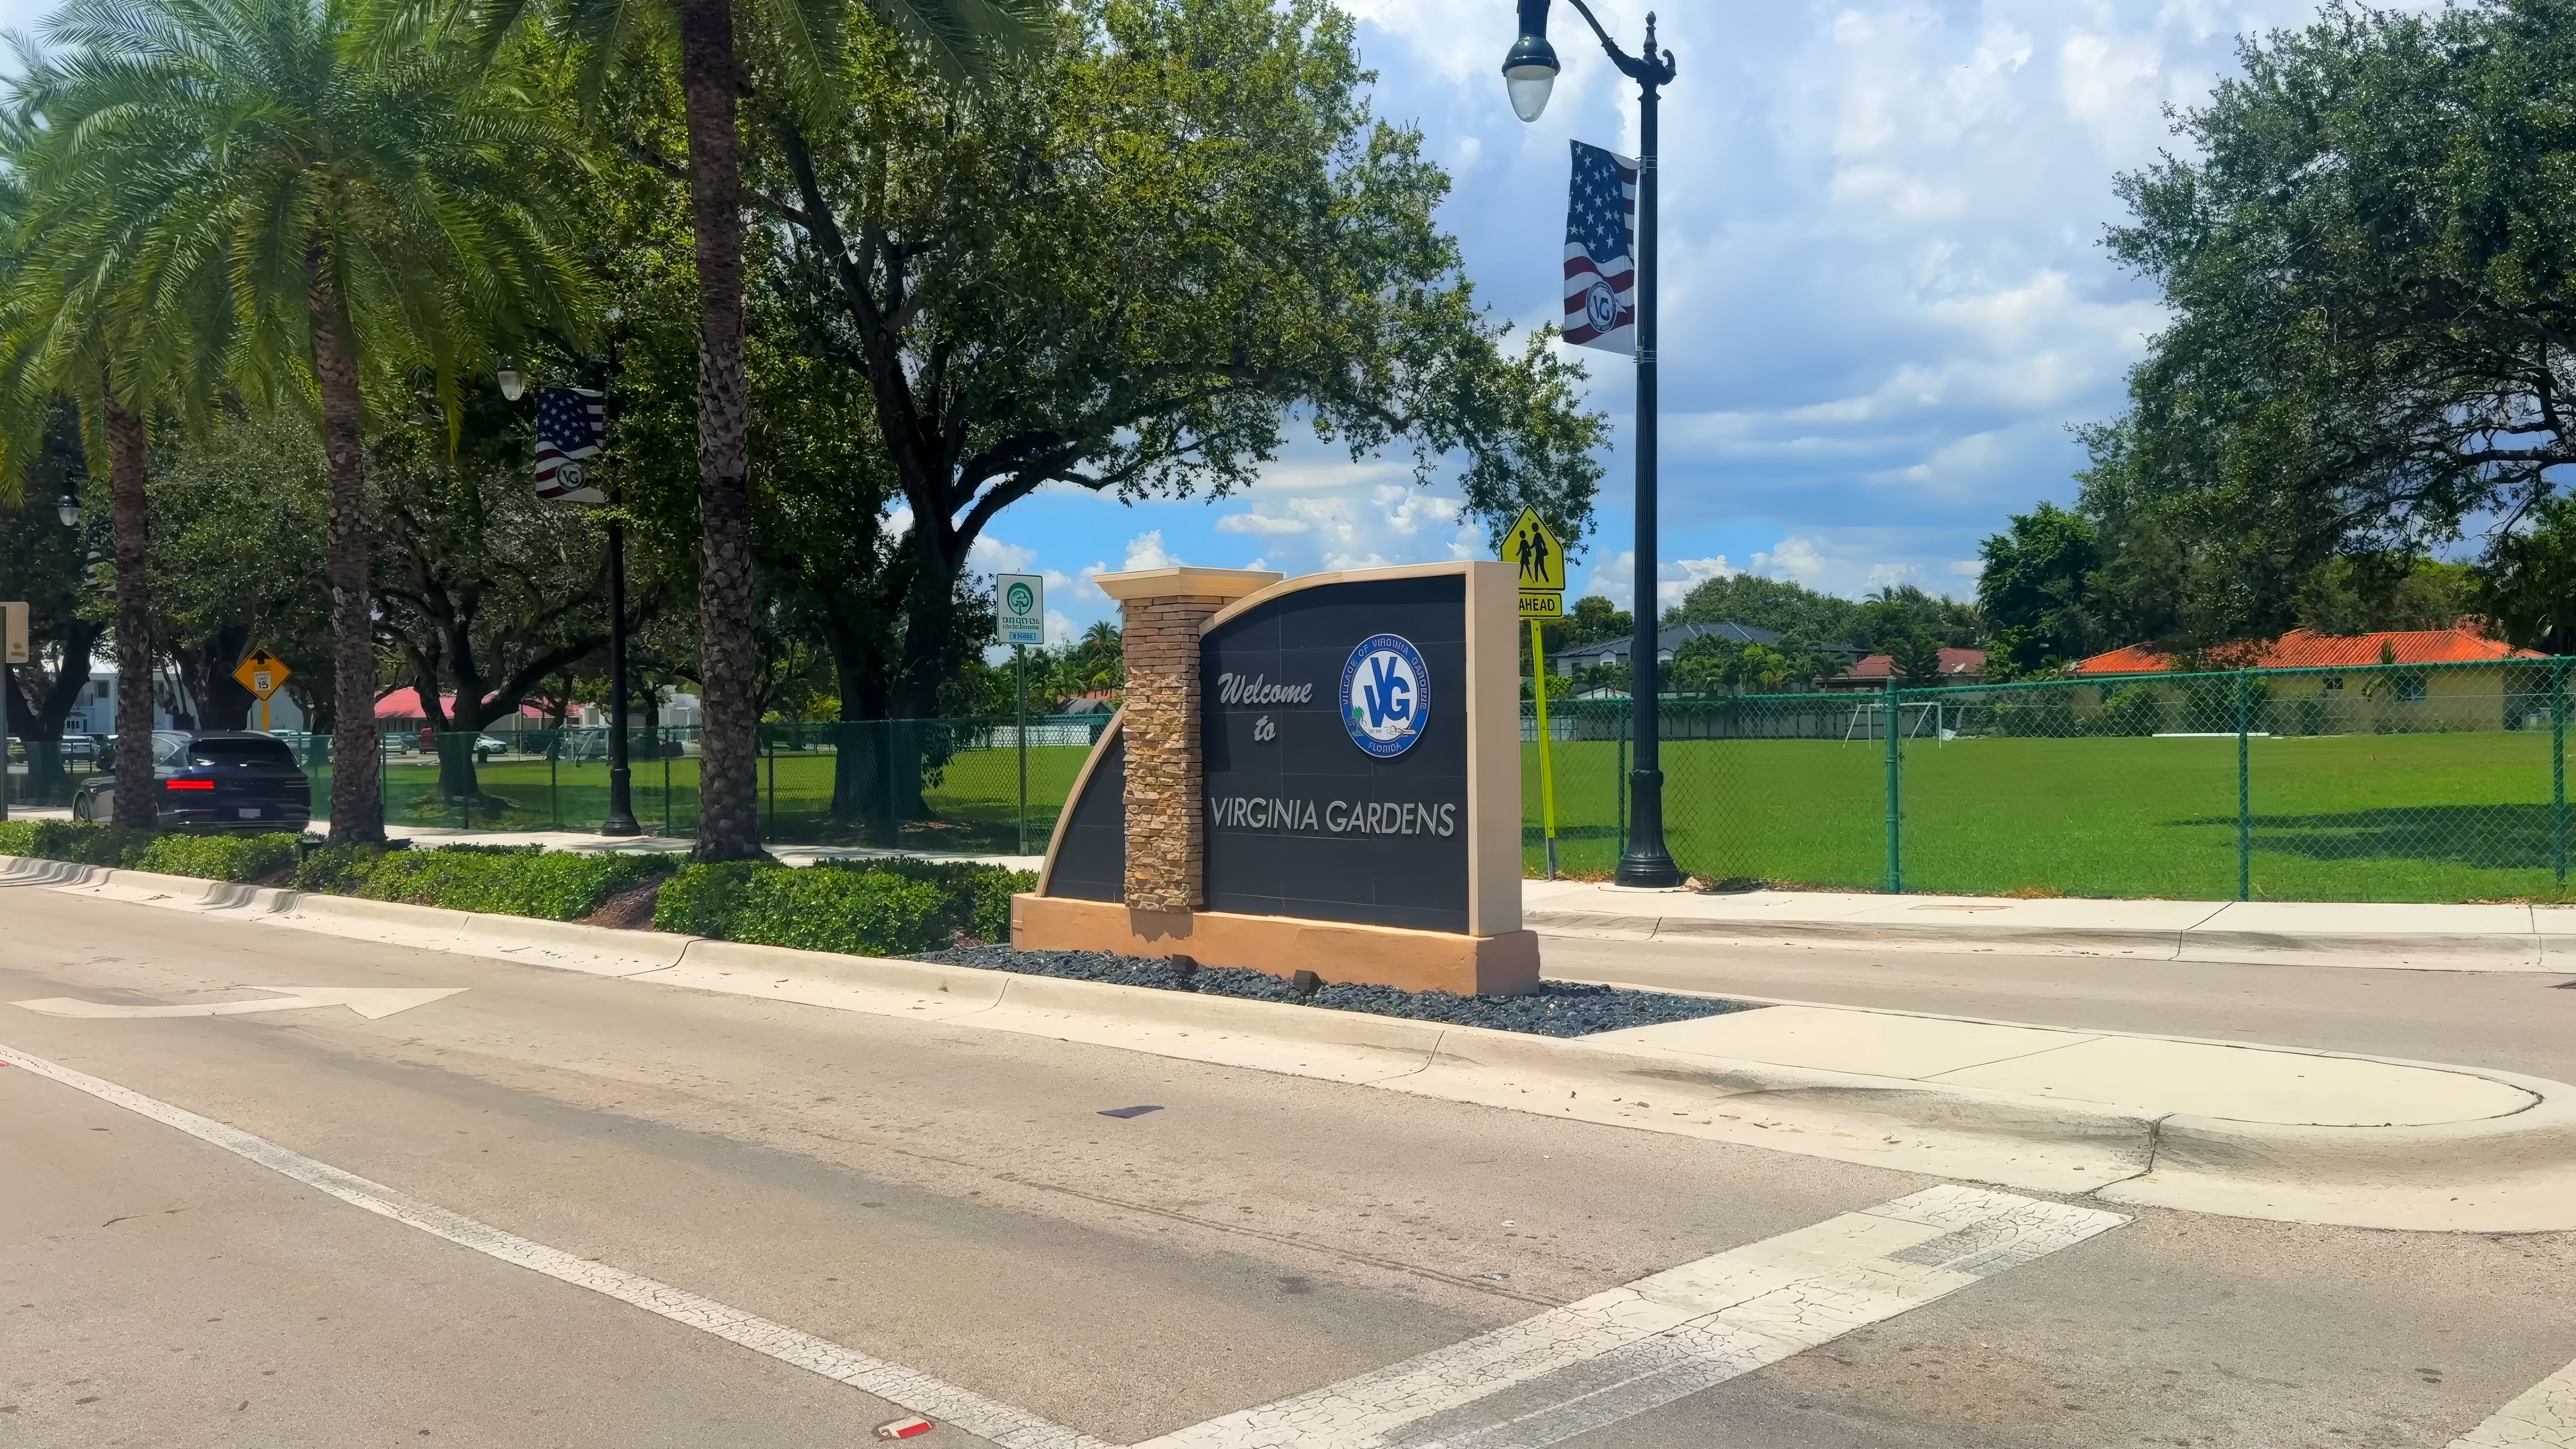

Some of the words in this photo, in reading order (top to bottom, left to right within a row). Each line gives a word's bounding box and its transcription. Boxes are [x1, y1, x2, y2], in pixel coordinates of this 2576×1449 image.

[1519, 598, 1555, 611] AHEAD
[1358, 645, 1368, 656] OF
[258, 680, 268, 689] 15
[1218, 672, 1313, 704] Welcome
[1253, 715, 1276, 741] to
[1211, 797, 1318, 831] VIRGINIA
[1326, 800, 1456, 837] GARDENS
